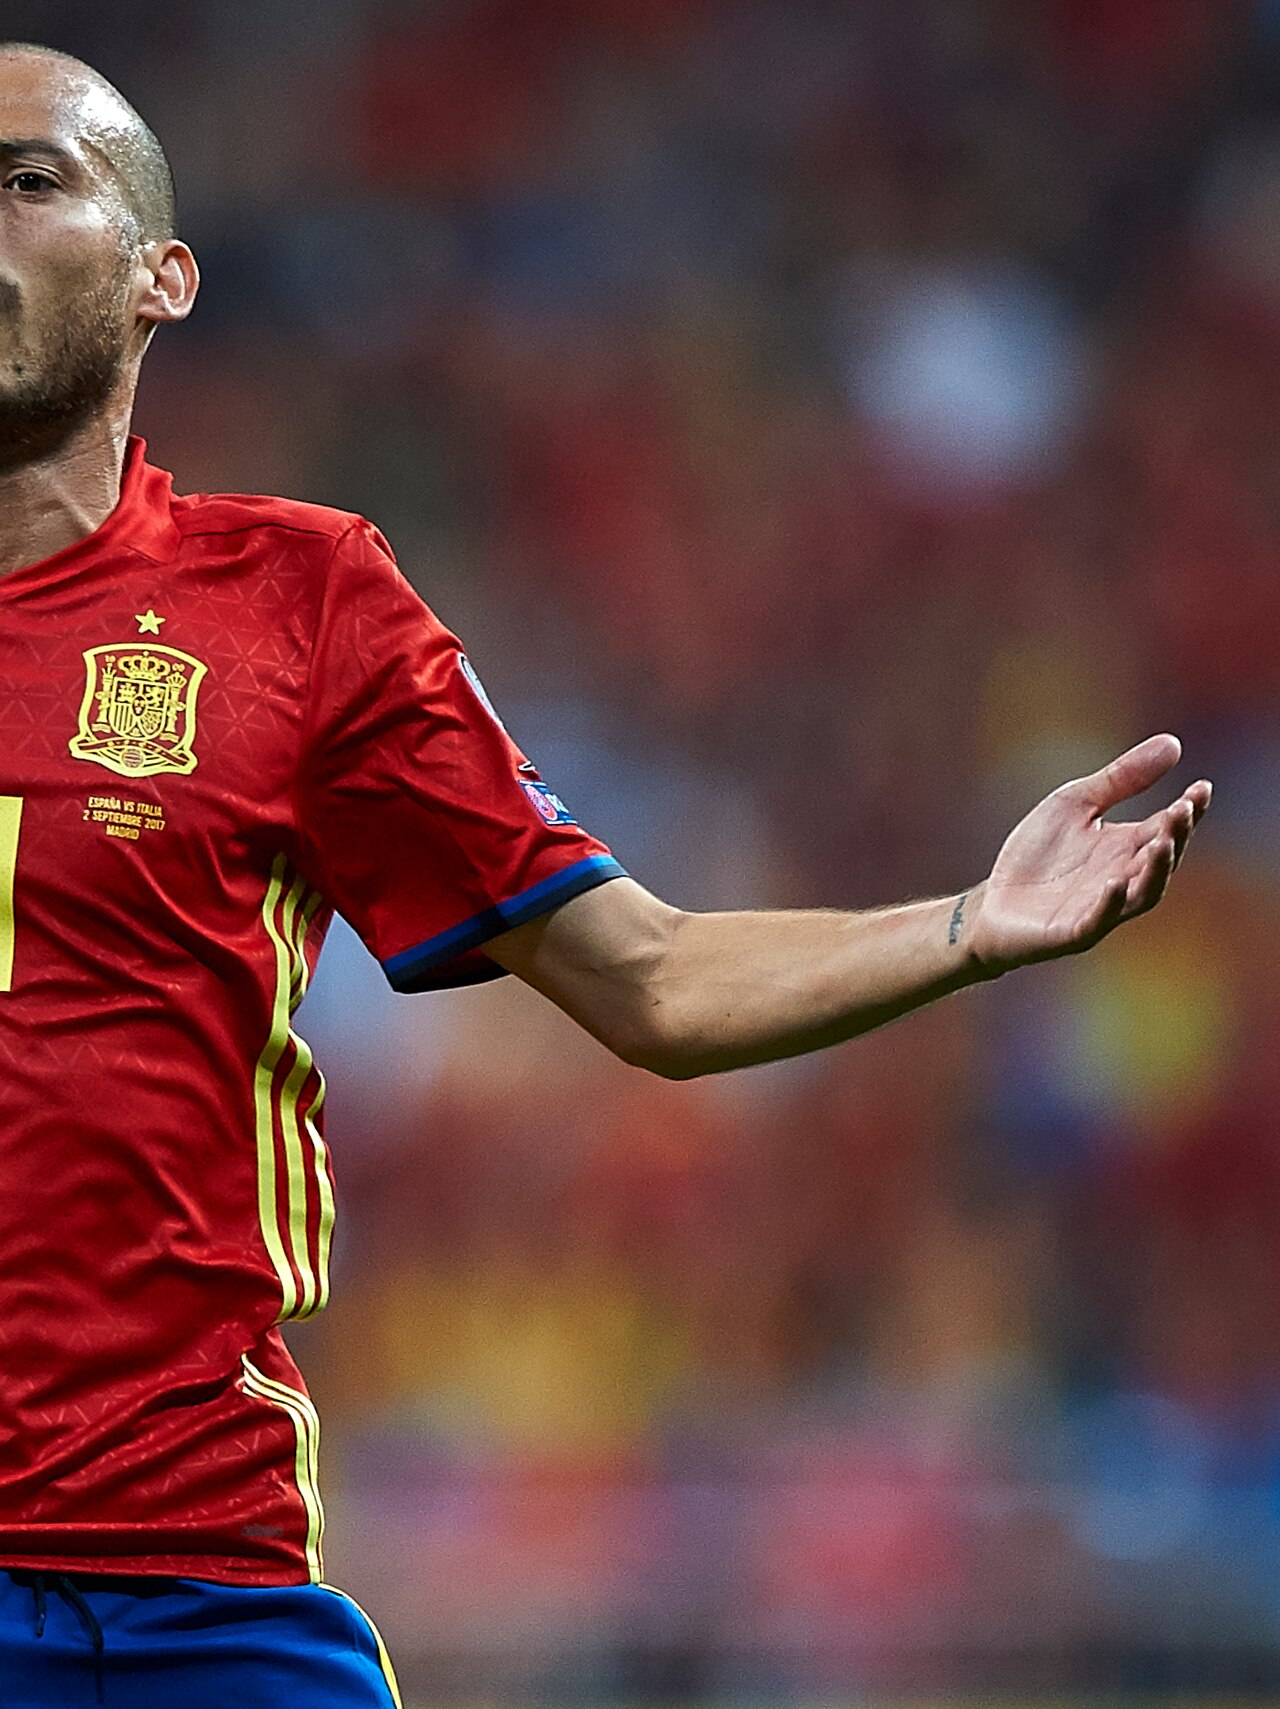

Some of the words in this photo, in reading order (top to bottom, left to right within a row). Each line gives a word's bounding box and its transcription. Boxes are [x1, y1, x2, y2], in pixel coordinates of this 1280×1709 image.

[88, 796, 121, 810] ESPAÑA
[123, 801, 135, 812] VS
[136, 803, 162, 817] ITALIA
[82, 810, 90, 820] 2
[92, 811, 142, 827] SEPTIEMBRE
[144, 818, 165, 831] 2017
[106, 825, 139, 839] MADRID
